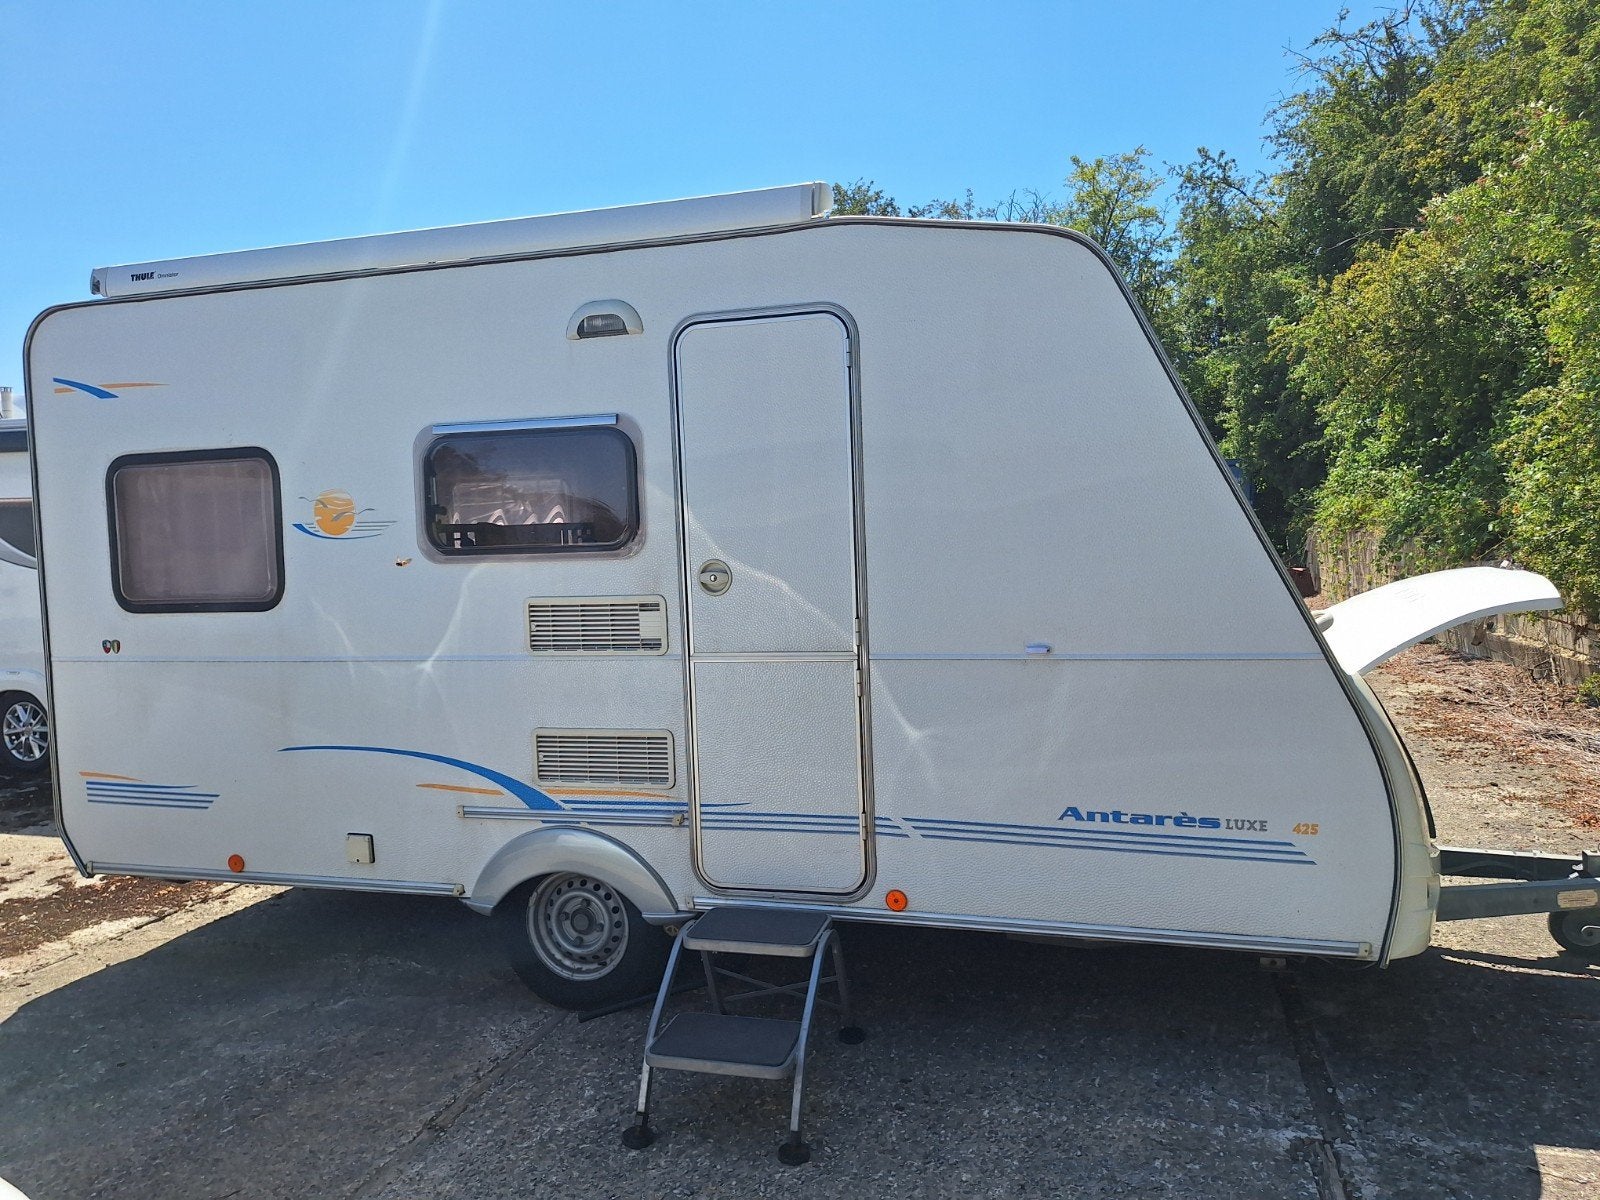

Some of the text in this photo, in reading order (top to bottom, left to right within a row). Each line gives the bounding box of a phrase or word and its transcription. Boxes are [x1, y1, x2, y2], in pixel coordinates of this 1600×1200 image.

[131, 272, 154, 281] THULE
[1058, 807, 1319, 835] Antarès LUXE 425
